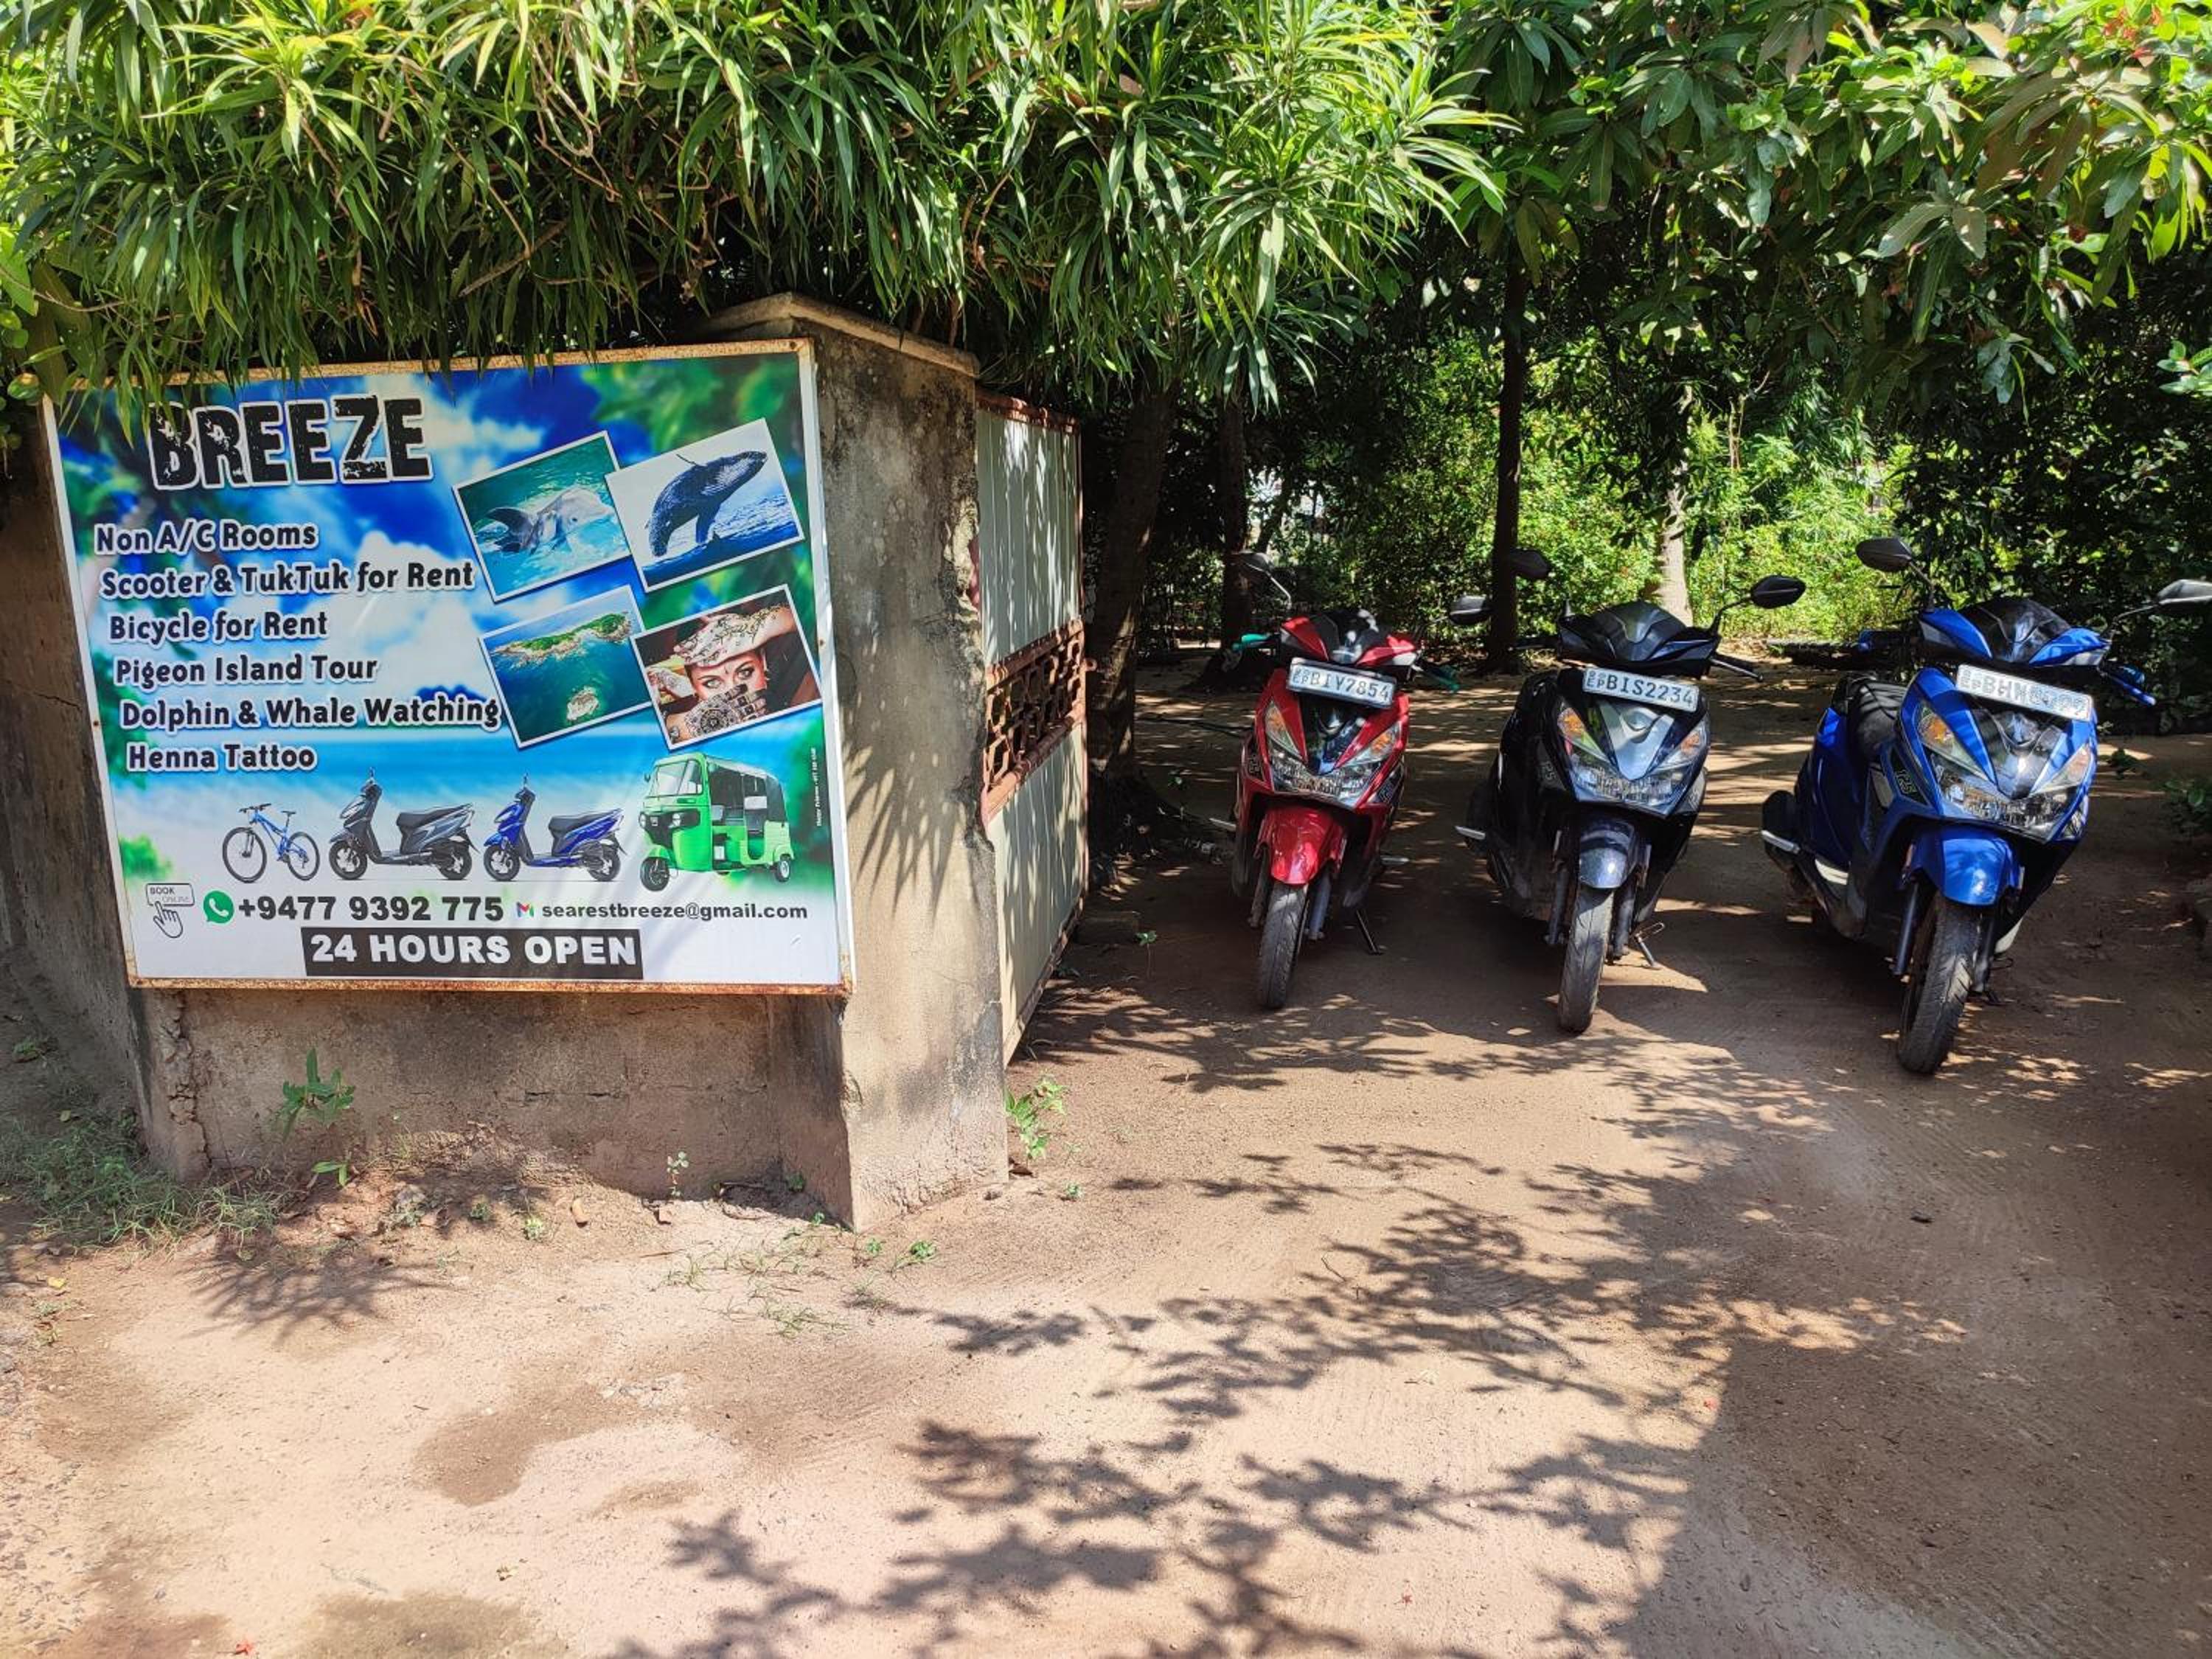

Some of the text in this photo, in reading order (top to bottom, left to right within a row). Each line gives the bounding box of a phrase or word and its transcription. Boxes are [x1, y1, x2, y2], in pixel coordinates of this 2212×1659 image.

[148, 396, 434, 490] BREEZE
[96, 521, 316, 553] Non A/C Rooms
[102, 561, 473, 598] Scooter & TukTuk for Rent
[110, 611, 327, 644] Bicycle for Rent
[116, 654, 378, 687] Pigeon Island Tour
[122, 695, 501, 731] Dolphin & Whale Watching
[128, 743, 315, 771] Henna Tattoo
[150, 886, 175, 895] BOOK
[239, 897, 504, 921] +9477 9392 775
[542, 902, 808, 921] searestbreeze@gmail.com
[311, 934, 636, 966] 24 HOURS OPEN
